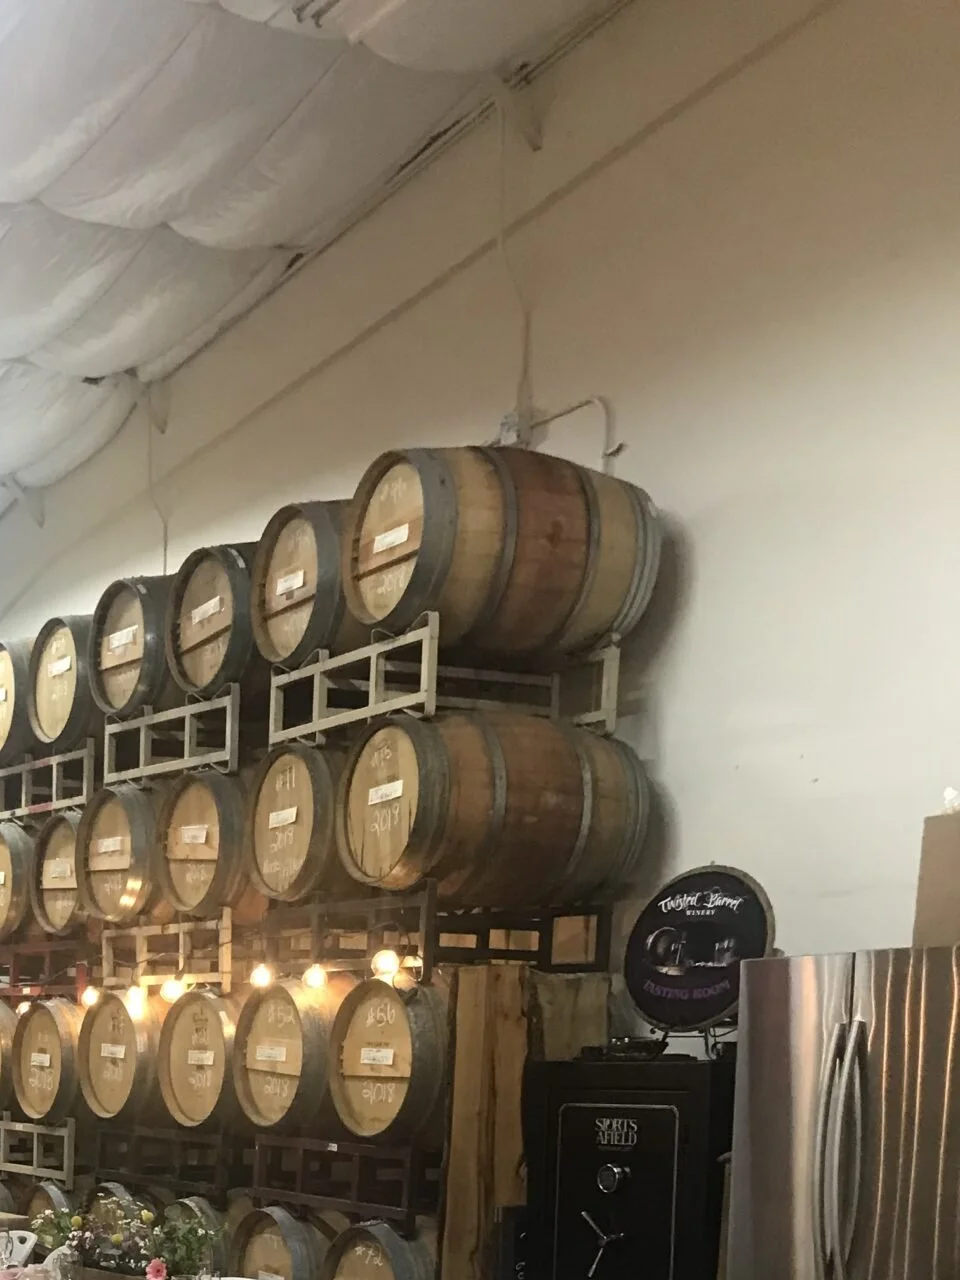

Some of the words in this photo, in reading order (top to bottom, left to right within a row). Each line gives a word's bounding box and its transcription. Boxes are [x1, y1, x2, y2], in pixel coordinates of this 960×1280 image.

[658, 892, 702, 913] Twisted
[703, 887, 746, 913] Barrel
[594, 1118, 638, 1132] SPORTS
[596, 1131, 638, 1146] AFIELD
